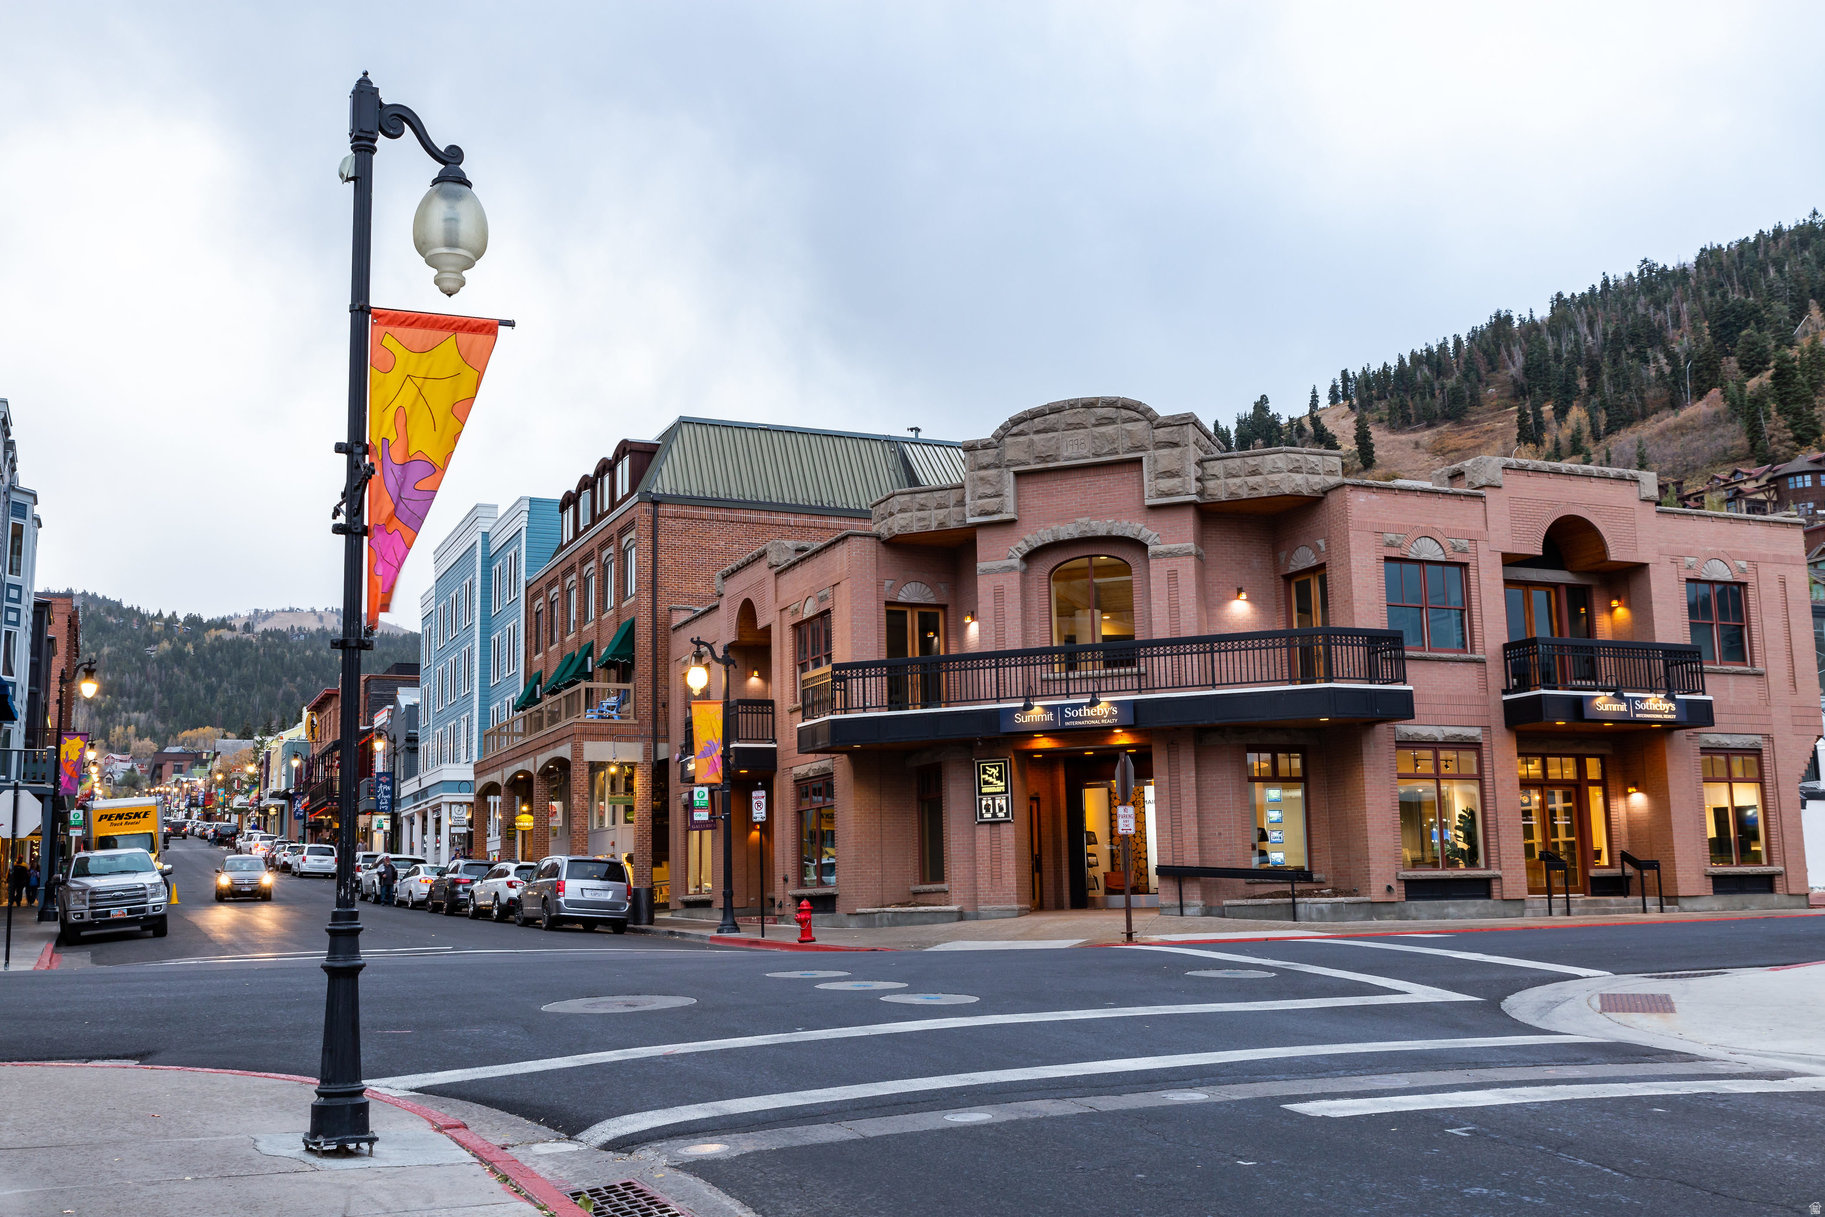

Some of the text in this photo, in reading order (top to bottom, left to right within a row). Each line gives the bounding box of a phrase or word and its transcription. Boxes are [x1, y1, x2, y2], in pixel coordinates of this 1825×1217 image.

[1595, 699, 1676, 713] Summit Sotheby's
[1014, 705, 1118, 724] Summit Sotheby's
[98, 810, 151, 822] PENSKE
